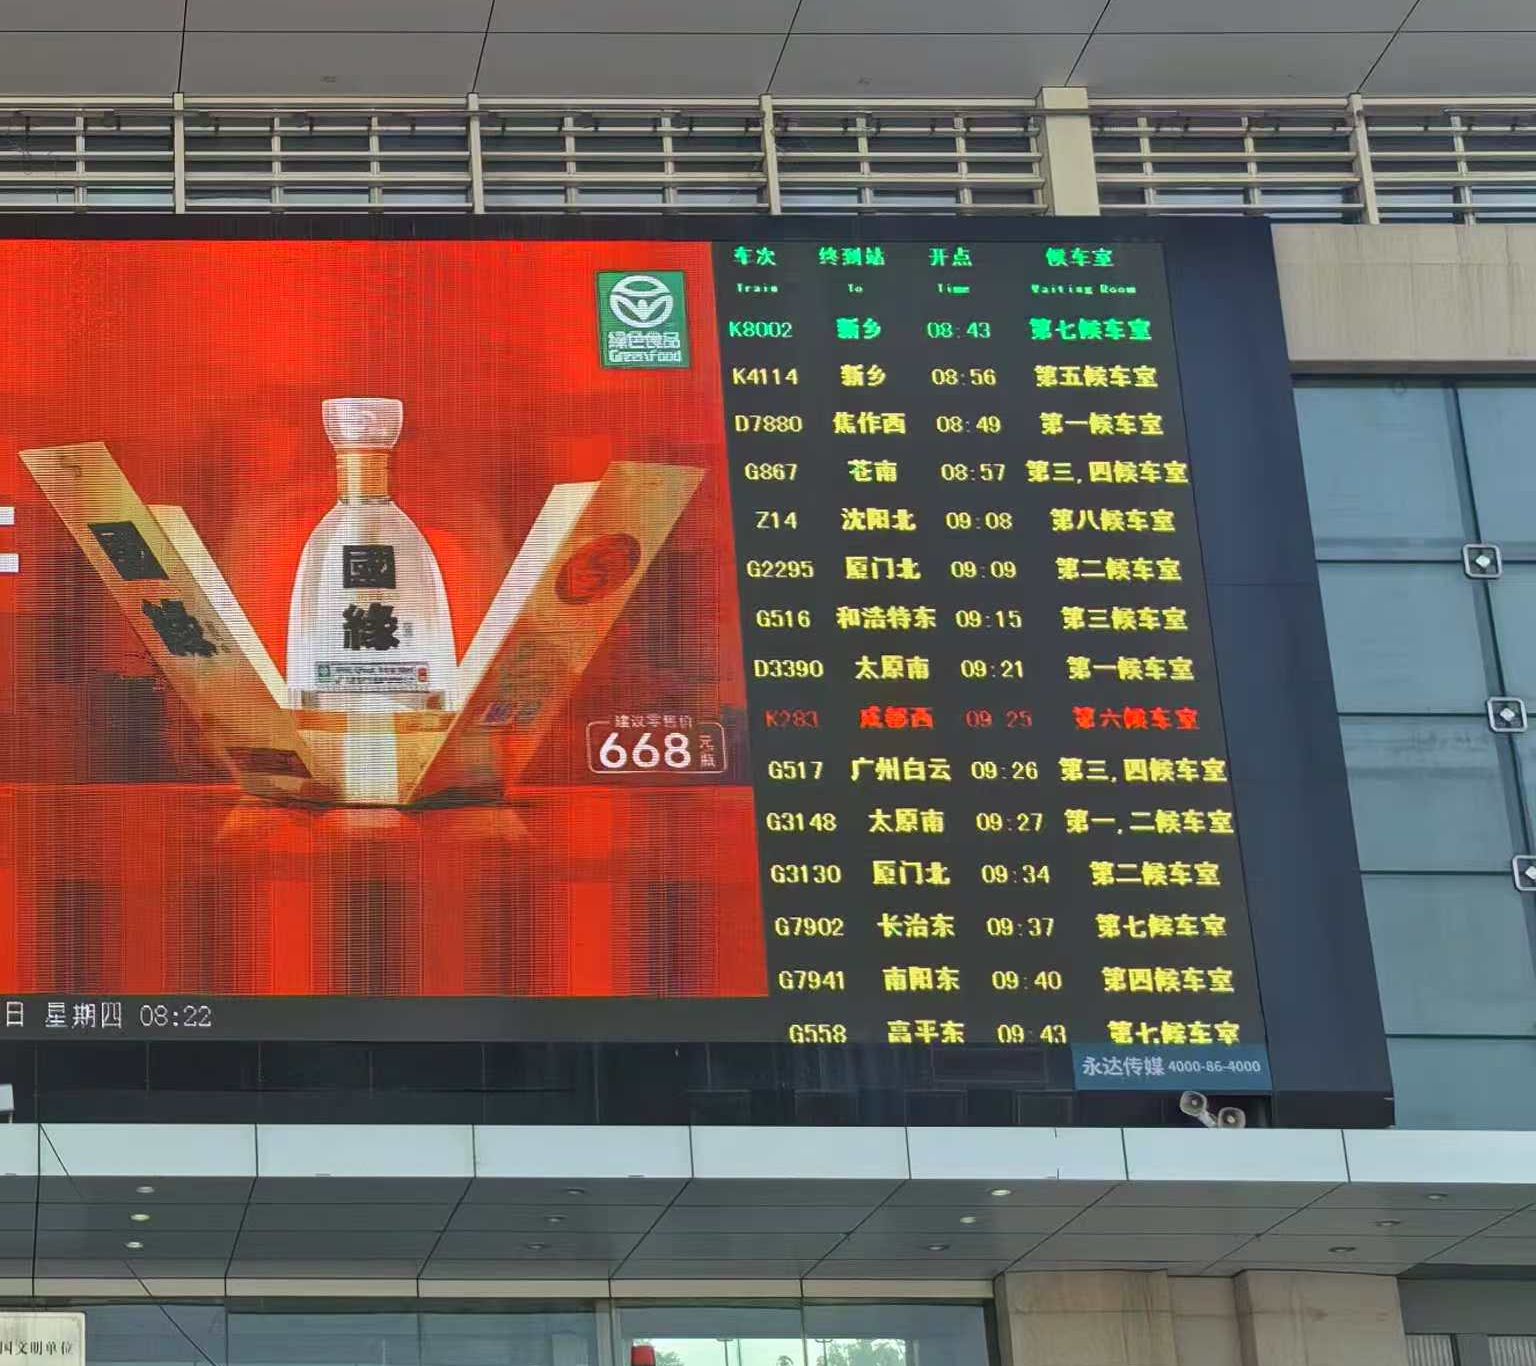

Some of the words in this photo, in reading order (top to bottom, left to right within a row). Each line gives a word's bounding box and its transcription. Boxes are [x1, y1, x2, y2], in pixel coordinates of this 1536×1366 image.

[729, 320, 792, 338] K8002
[924, 321, 991, 339] 08:43
[1027, 316, 1152, 343] 第七候车室
[732, 368, 799, 385] K4114
[840, 364, 886, 387] 新乡
[931, 368, 997, 387] 08:56
[1033, 365, 1158, 390] 第五候车室
[734, 415, 803, 433] D7880
[832, 411, 907, 435] 焦作西
[936, 415, 1001, 434] 08:49
[1040, 412, 1164, 437] 第一候车室
[744, 463, 797, 481] G867
[940, 464, 1005, 481] 08:57
[757, 511, 797, 529] Z14
[841, 507, 916, 531] 沈阳北
[945, 512, 1012, 530] 09:08
[1049, 508, 1175, 533] 第八候车室
[746, 561, 813, 579] G2295
[950, 561, 1017, 579] 09:09
[1056, 556, 1181, 583] 第二候车室
[756, 610, 811, 628] G516
[955, 610, 1021, 628] 09:15
[1060, 606, 1188, 632] 第三候车室
[753, 660, 824, 678] D3390
[856, 655, 929, 680] 太原南
[960, 660, 1022, 679] 09:21
[1066, 656, 1193, 682] 第一候车室
[599, 732, 691, 768] 668
[768, 762, 822, 780] G517
[850, 756, 951, 782] 广州白云
[971, 762, 1038, 780] 09:26
[767, 812, 837, 832] G3148
[869, 808, 944, 834] 太原南
[976, 813, 1043, 833] 09:27
[771, 865, 842, 884] G3130
[981, 864, 1050, 884] 09:34
[1089, 861, 1221, 888] 第二候车室
[774, 917, 844, 937] G7902
[876, 913, 955, 939] 长治东
[986, 917, 1053, 937] 09:37
[1094, 913, 1226, 939] 第七候车室
[778, 971, 845, 991] G7941
[883, 965, 960, 992] 南阳东
[992, 971, 1063, 990] 09:40
[1100, 966, 1232, 994] 第四候车室
[45, 1001, 123, 1029] 星期四
[140, 1004, 213, 1027] 08:22
[1082, 1056, 1164, 1077] 永达传媒
[1168, 1060, 1262, 1073] 4000-86-4000
